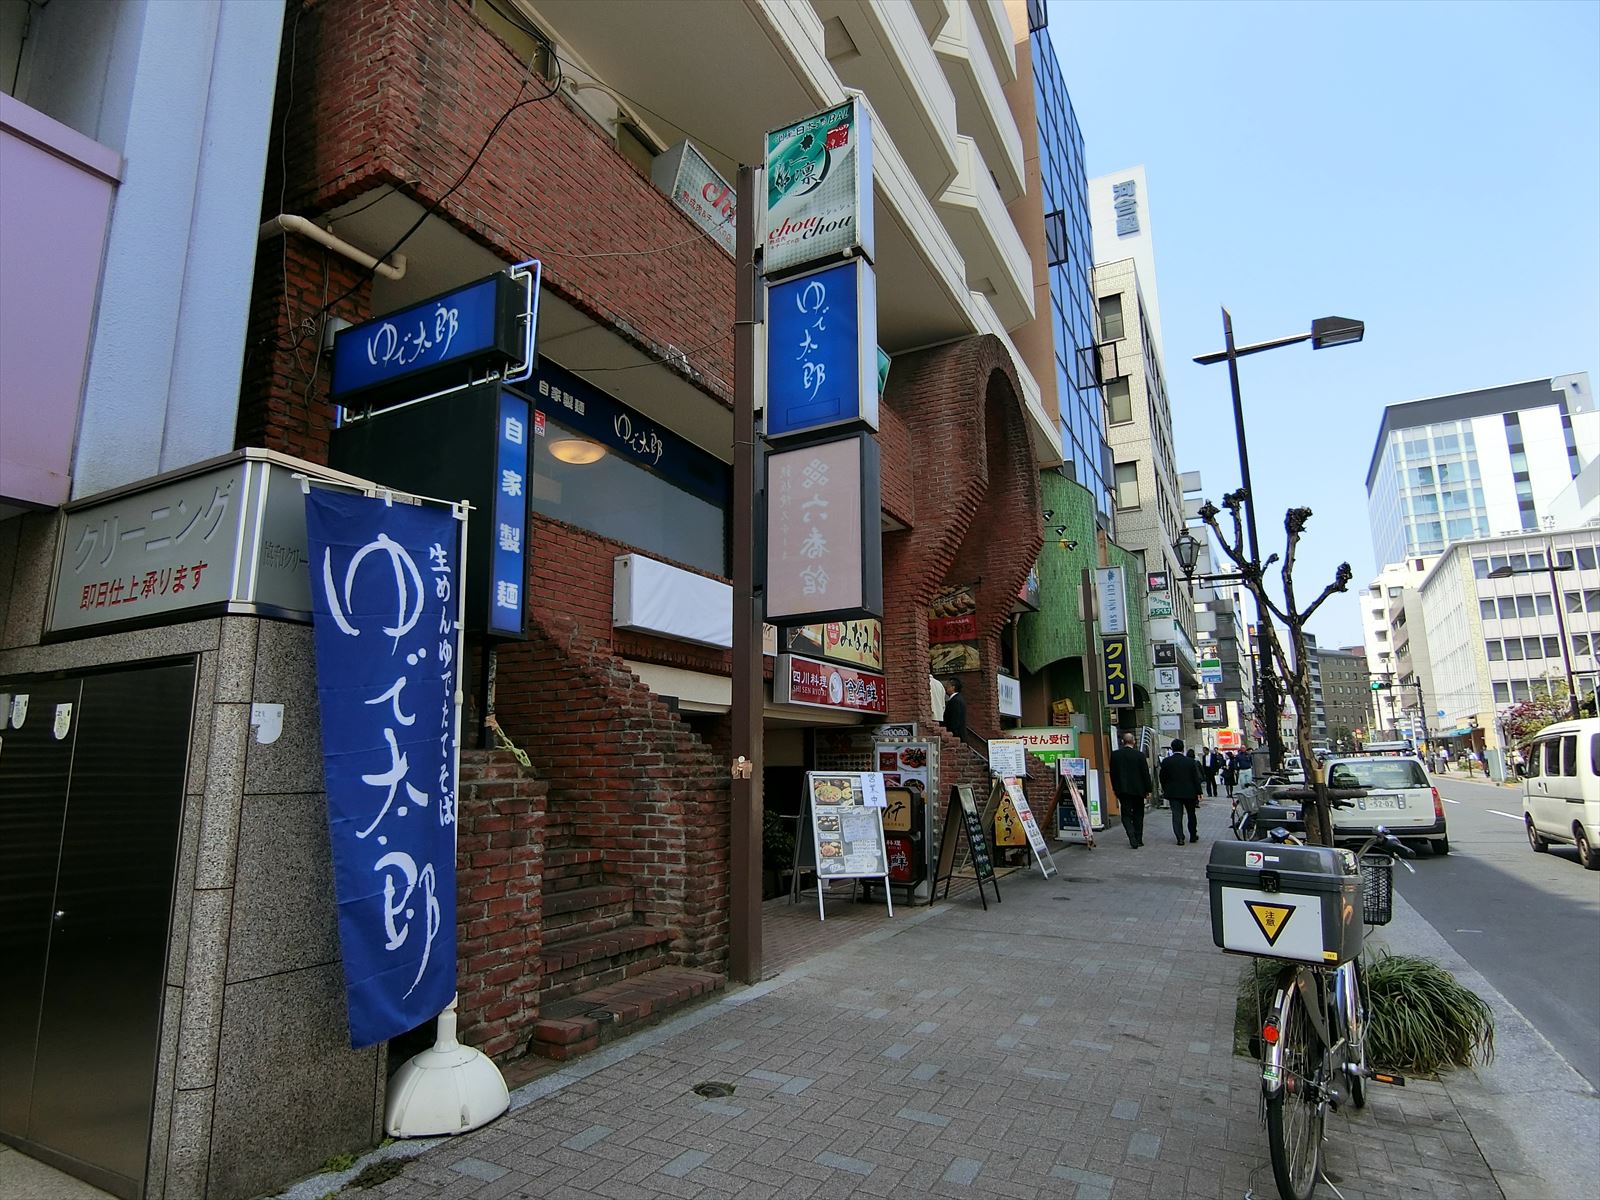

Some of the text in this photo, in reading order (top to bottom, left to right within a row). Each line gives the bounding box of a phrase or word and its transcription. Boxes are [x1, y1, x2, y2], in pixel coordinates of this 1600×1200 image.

[769, 216, 817, 241] chou
[802, 215, 852, 241] chou
[367, 303, 459, 367] ゆで太郎
[796, 281, 829, 401] ゆで太郎
[538, 380, 586, 416] 自家製麺
[614, 413, 663, 465] ゆで太郎
[75, 479, 235, 575] クリーニング
[497, 416, 523, 610] 自家製麺
[80, 560, 208, 611] 即日仕上承ります
[429, 543, 455, 826] 生めんゆでたてそば
[792, 670, 828, 689] 四川料理
[1106, 643, 1125, 700] クスリ
[1010, 734, 1070, 745] 方せん受付
[322, 533, 440, 1000] ゆで太郎
[1265, 910, 1276, 927] 注意
